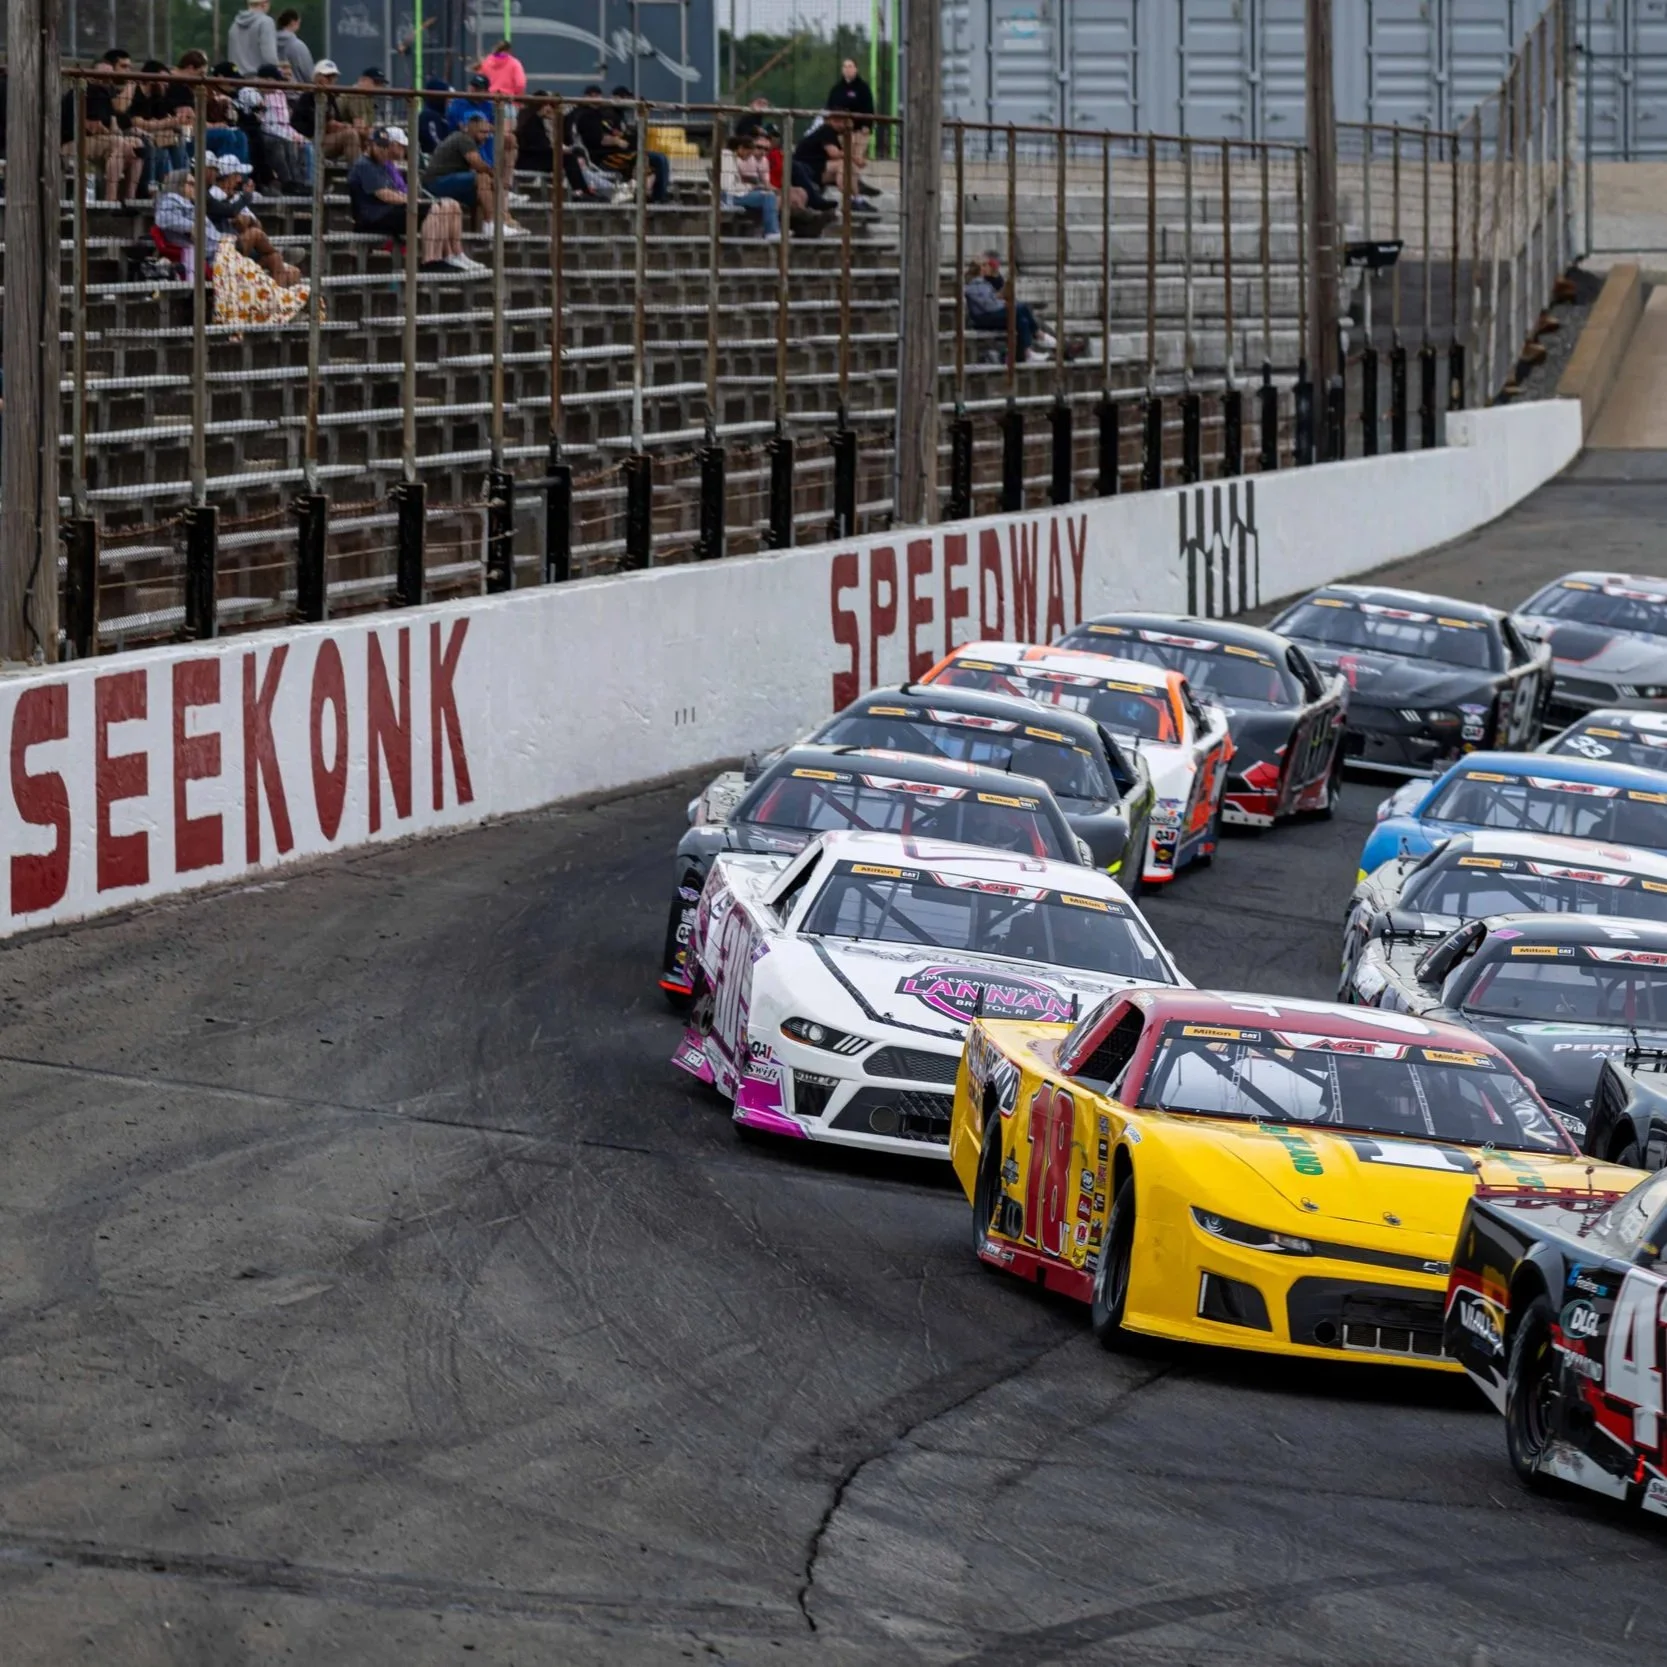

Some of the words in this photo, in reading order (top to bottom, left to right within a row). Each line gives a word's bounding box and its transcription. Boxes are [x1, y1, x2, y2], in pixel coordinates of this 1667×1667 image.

[831, 514, 1087, 712] SPEEDWAY
[10, 617, 474, 915] SEEKONK
[861, 866, 894, 875] Milton
[1069, 897, 1101, 908] Milton
[903, 979, 1073, 1017] LANNAN
[1193, 1028, 1232, 1037] Milton
[751, 1040, 772, 1059] QA1
[744, 1063, 778, 1079] Swift
[1023, 1079, 1075, 1258] 18
[1604, 1268, 1667, 1450] 4
